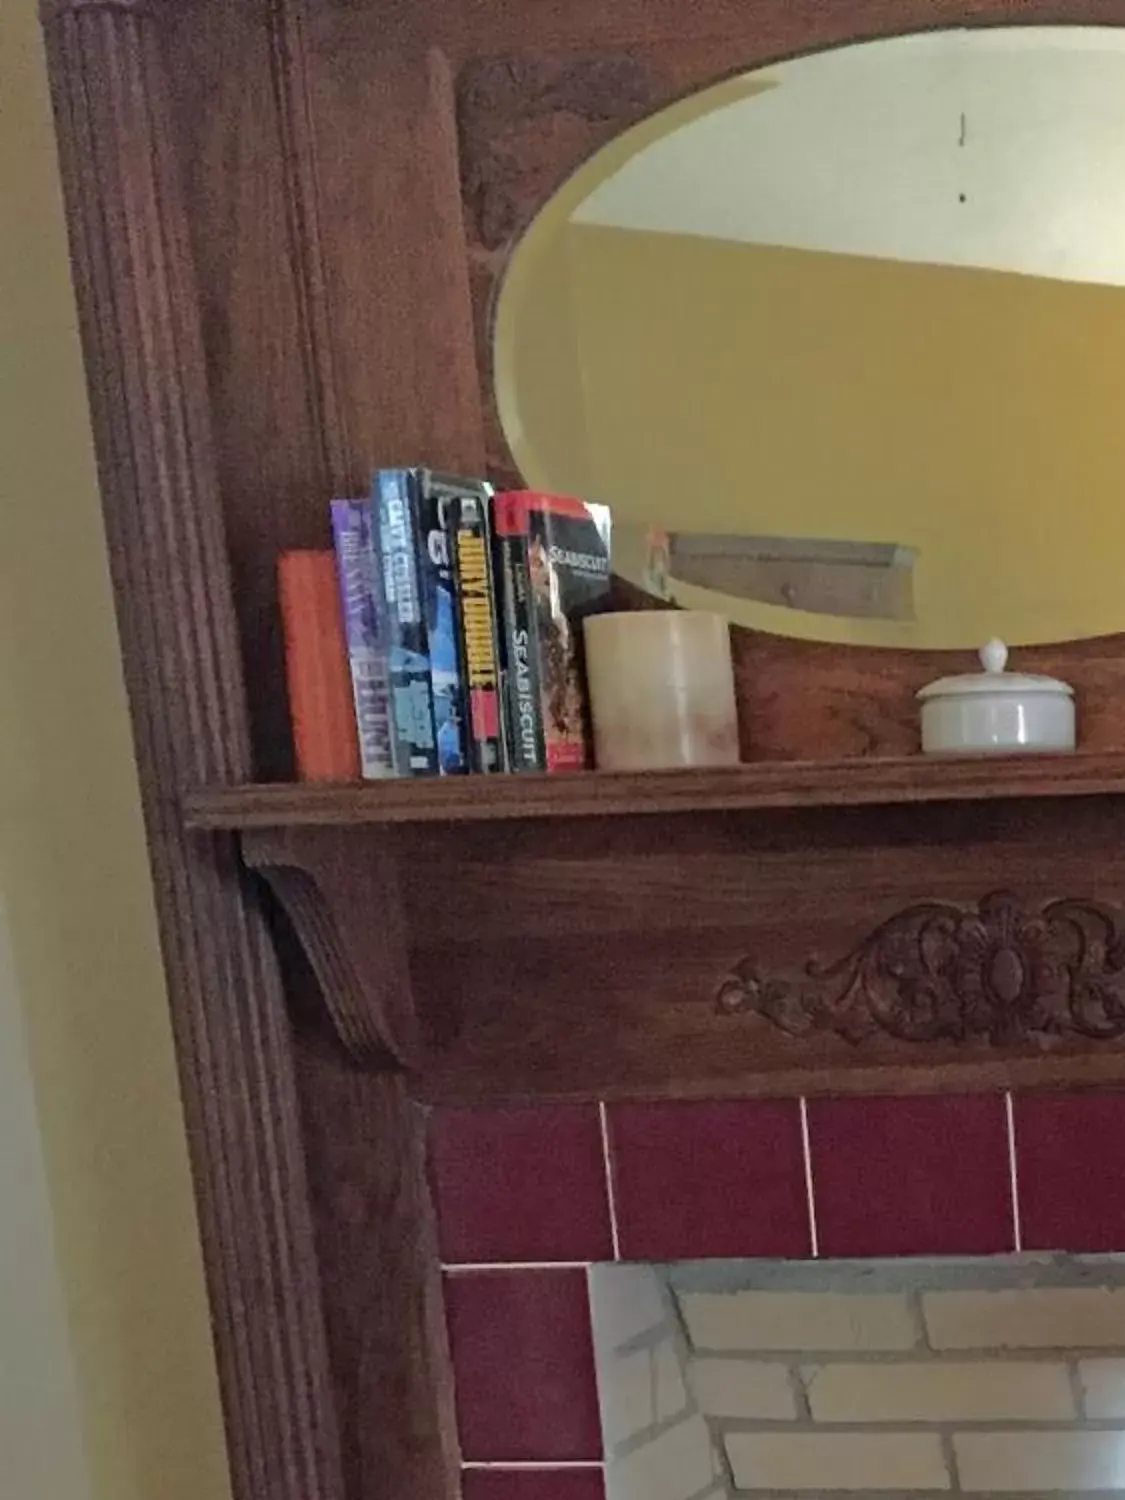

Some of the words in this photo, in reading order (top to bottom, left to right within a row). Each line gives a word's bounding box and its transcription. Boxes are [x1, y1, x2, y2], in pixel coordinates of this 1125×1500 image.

[457, 529, 488, 592] JURY
[462, 597, 497, 686] DOUBLE
[512, 629, 537, 764] SEABISCUIT
